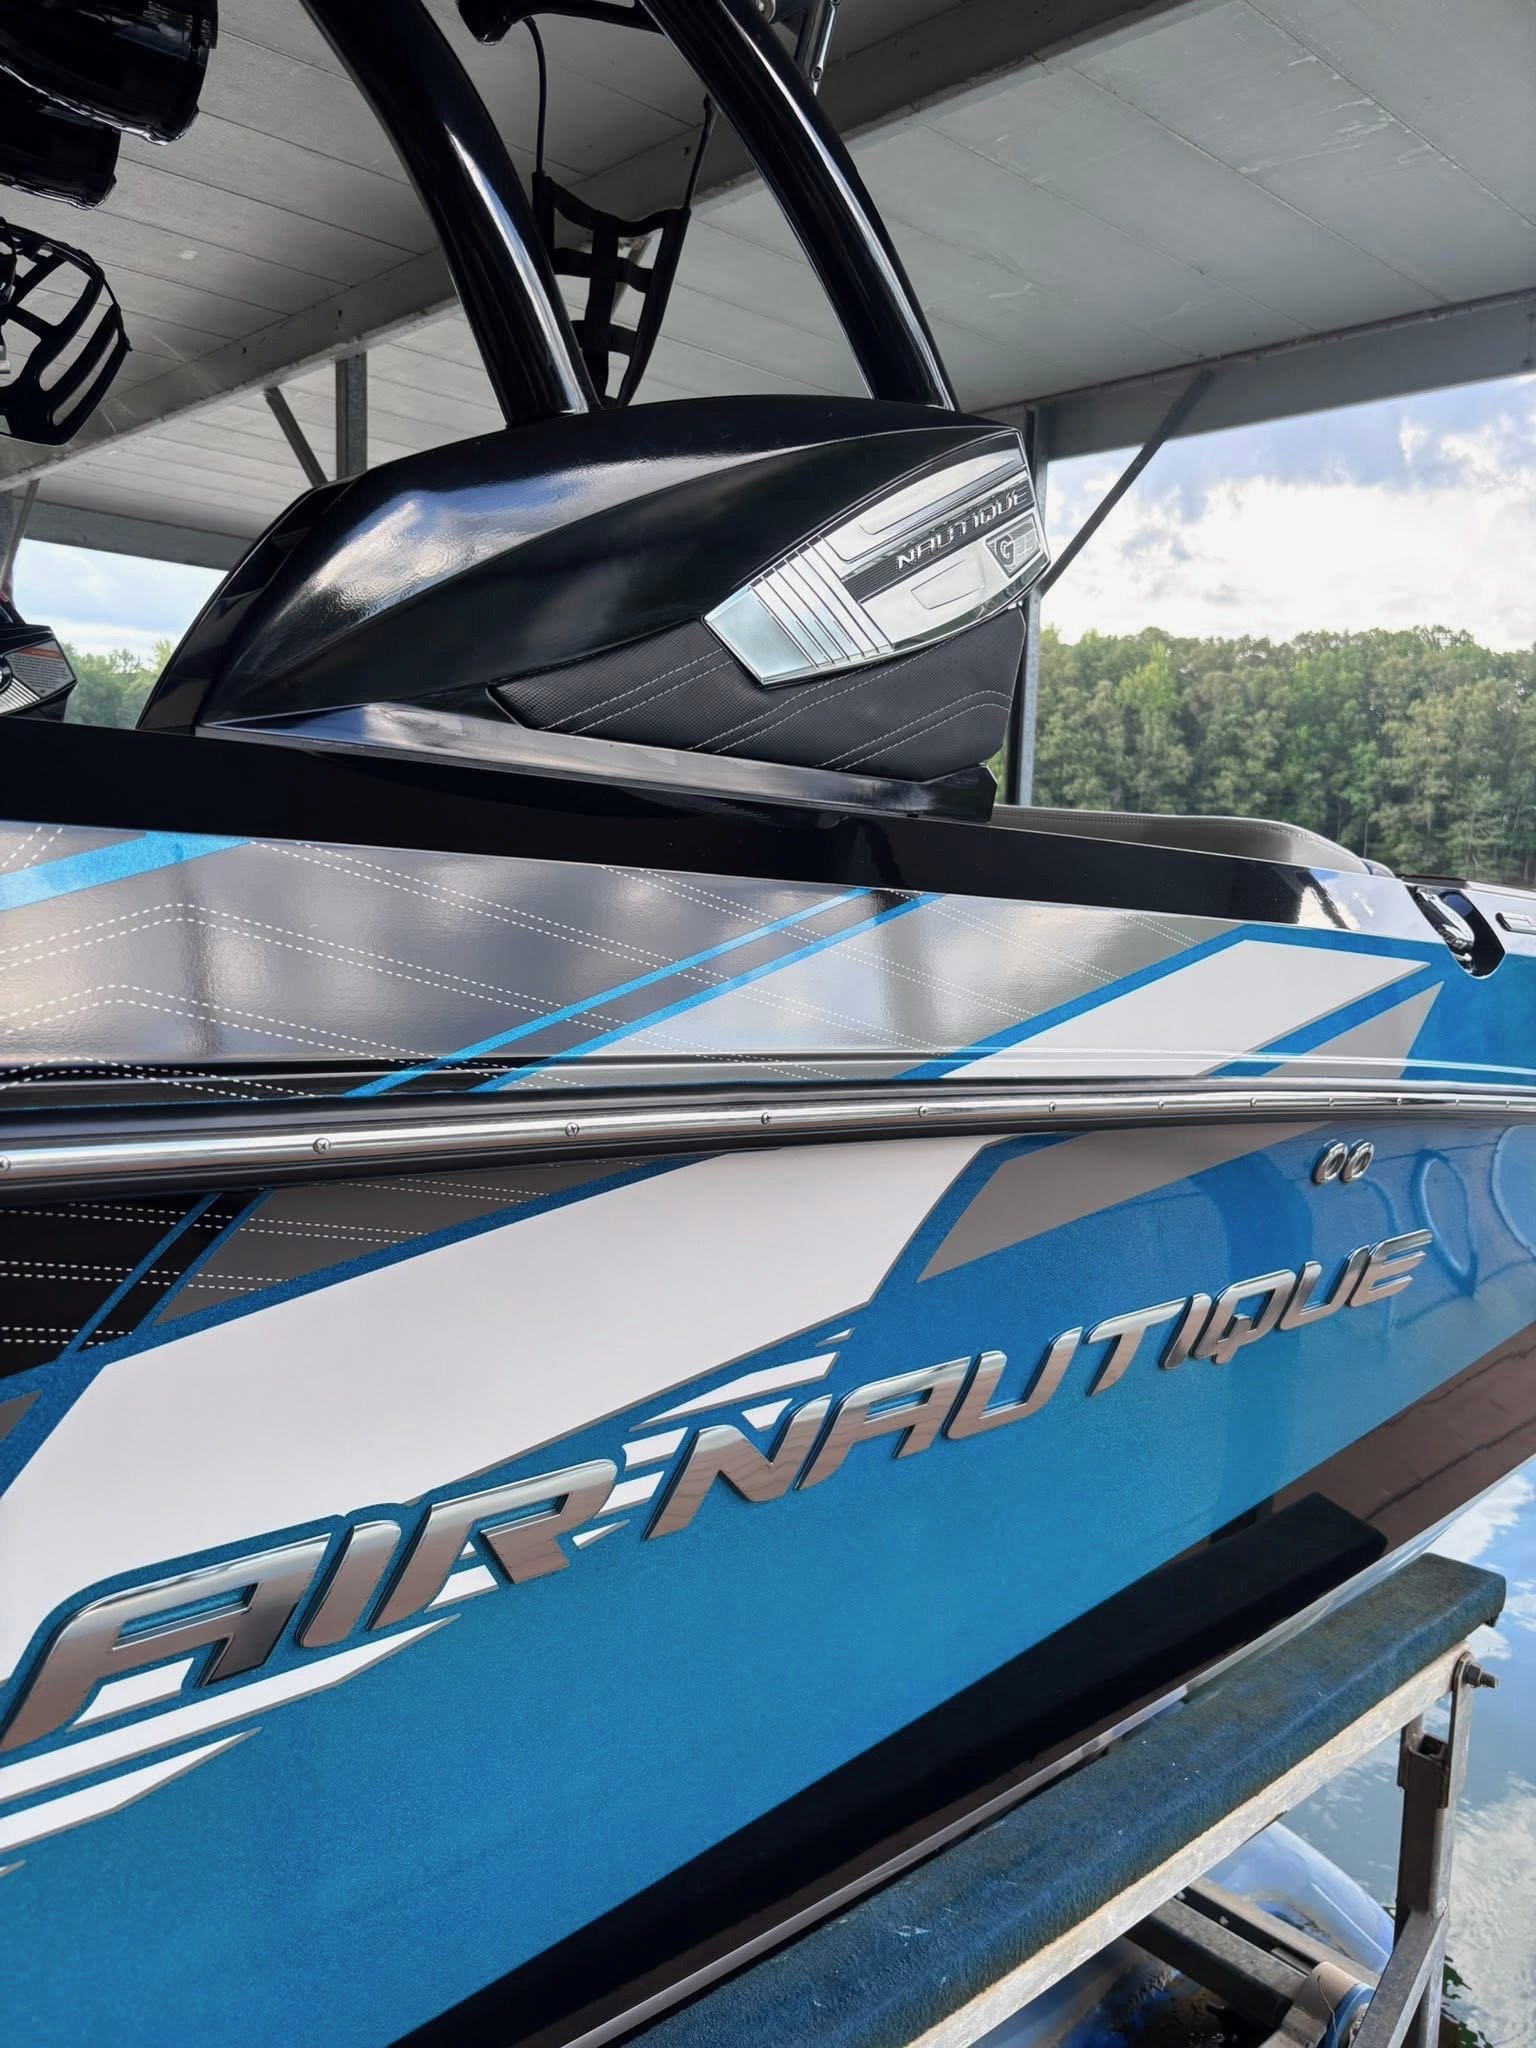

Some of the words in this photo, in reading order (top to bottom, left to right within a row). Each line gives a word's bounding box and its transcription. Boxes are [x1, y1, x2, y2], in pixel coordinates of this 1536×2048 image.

[896, 486, 1027, 569] NAUTIQUE
[0, 1458, 618, 1751] AIR
[641, 1228, 1433, 1542] NAUTIQUE
